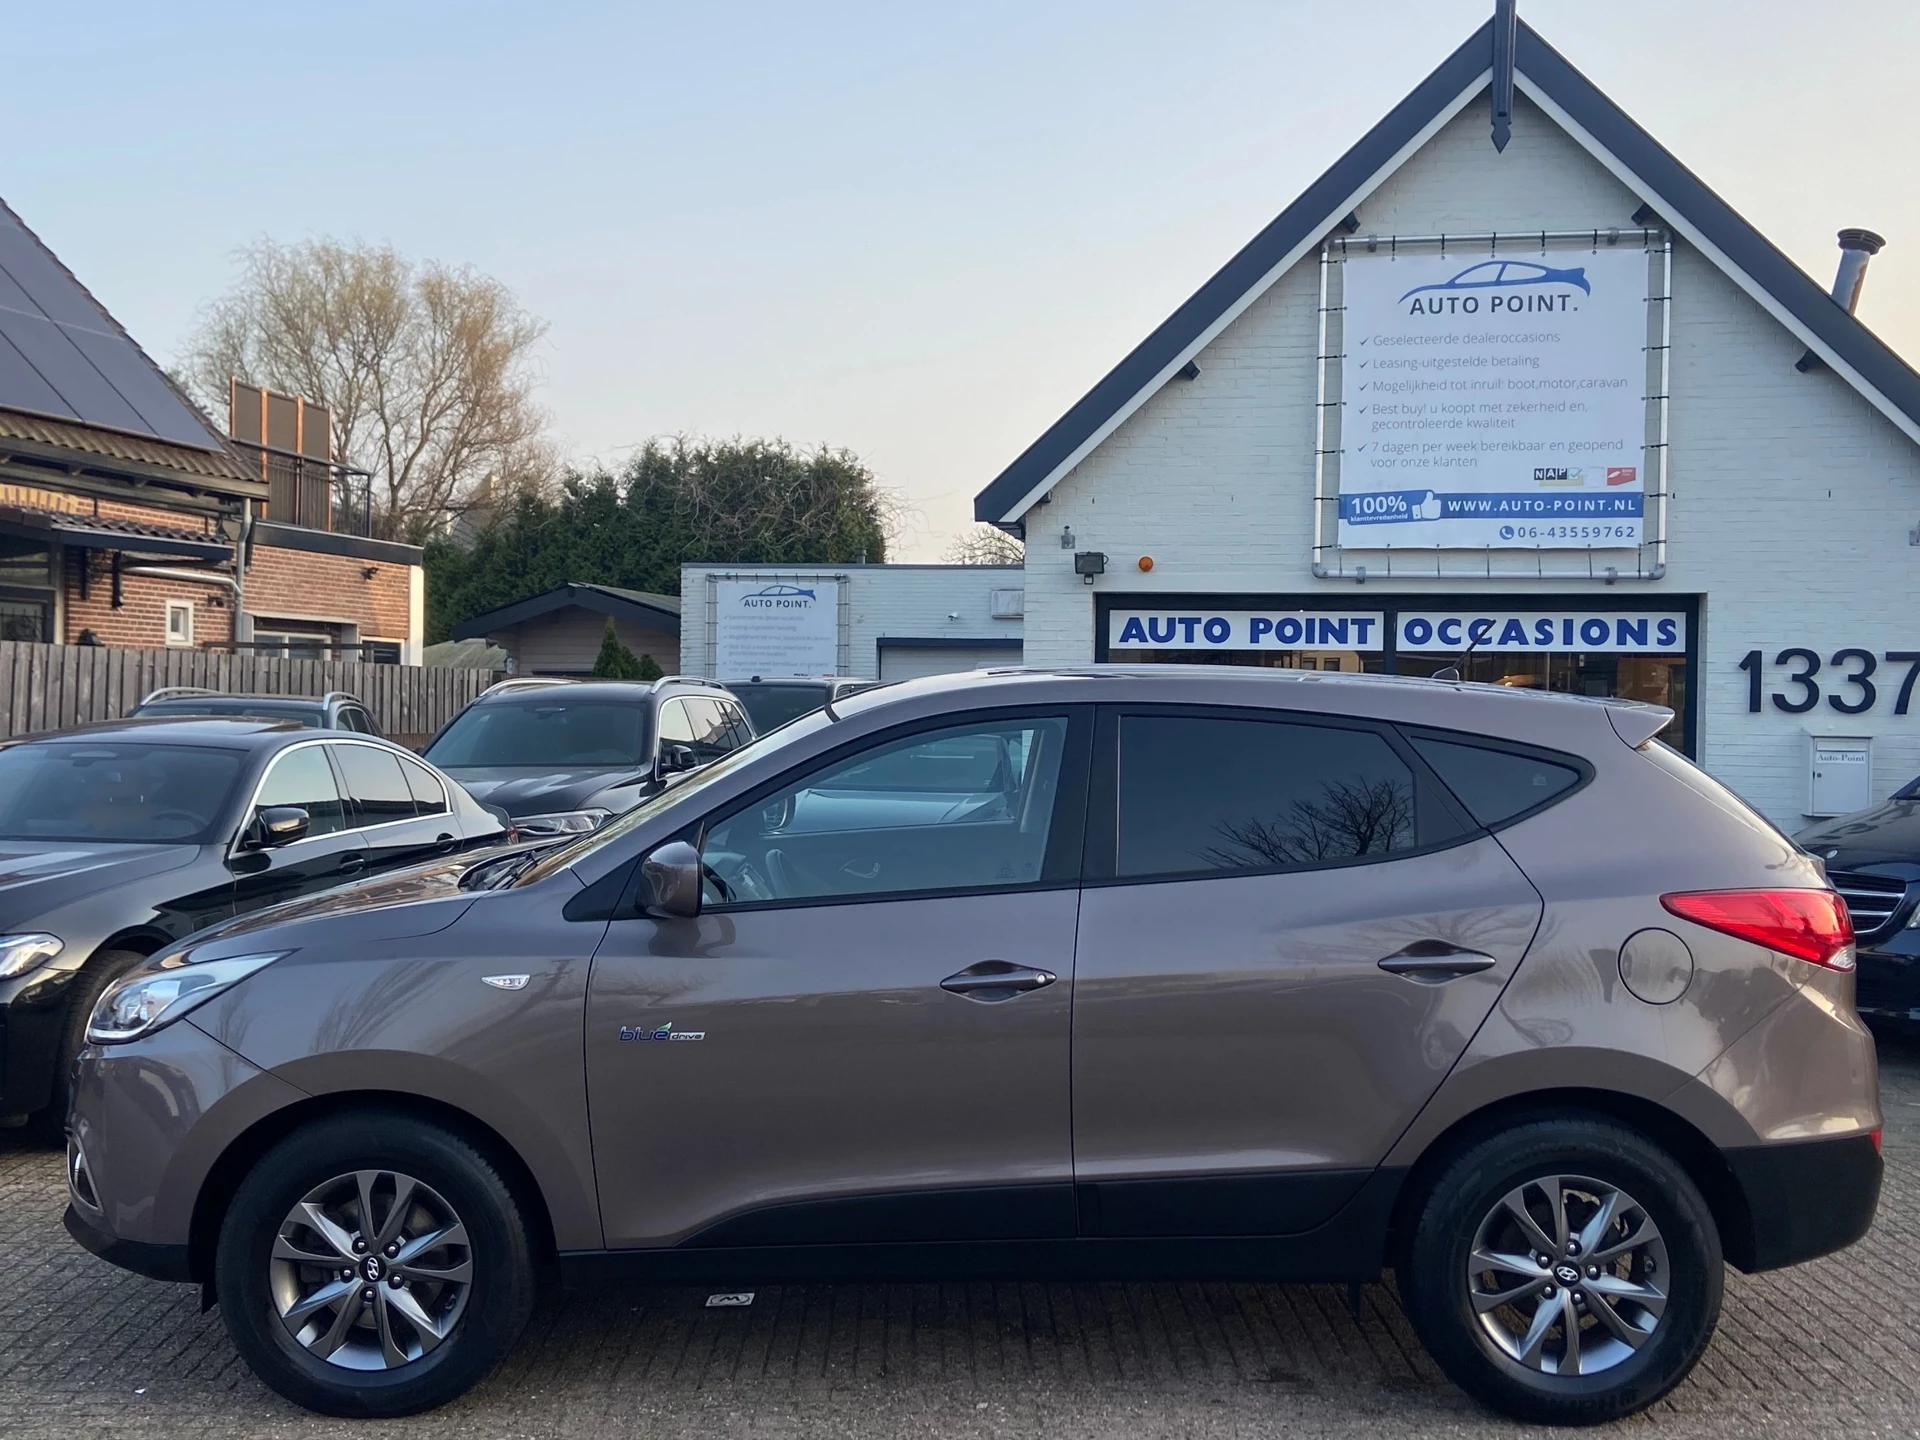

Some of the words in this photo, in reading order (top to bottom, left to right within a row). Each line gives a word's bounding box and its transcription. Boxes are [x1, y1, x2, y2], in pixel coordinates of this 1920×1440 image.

[1409, 296, 1479, 315] AUTO
[1373, 333, 1460, 346] Geselecteerde
[1462, 332, 1561, 344] dealeroccasions
[1373, 356, 1488, 371] Leasing-uitgestelde
[1491, 354, 1540, 369] betaling
[1372, 379, 1447, 394] Mogelijkheid
[1450, 380, 1468, 391] tot
[1372, 403, 1398, 415] Best
[1430, 404, 1438, 414] u
[1441, 402, 1476, 416] koopt
[1479, 403, 1503, 414] met
[1506, 401, 1566, 413] zekerheid
[1371, 418, 1463, 433] gecontroleerde
[1466, 418, 1515, 429] kwaliteit
[1371, 442, 1379, 452] 7
[1382, 441, 1419, 455] dagen
[1422, 442, 1443, 454] per
[1446, 441, 1478, 452] week
[1480, 440, 1546, 452] bereikbaar
[1549, 441, 1565, 451] en
[1567, 439, 1623, 454] geopend
[1371, 458, 1398, 468] voor
[1400, 457, 1430, 468] onze
[1433, 456, 1477, 467] klanten
[1351, 495, 1407, 514] 100%
[1448, 499, 1636, 512] WWW.AUTO-POINT.NL
[1517, 526, 1635, 538] 06-43559762
[743, 599, 772, 608] AUTO
[1118, 615, 1231, 645] AUTO
[1249, 616, 1376, 645] POINT
[1403, 617, 1677, 647] OCCASIONS
[1738, 647, 1920, 715] 1337
[1817, 753, 1865, 762] Auto-Point
[619, 1025, 669, 1041] blue
[671, 1032, 703, 1040] drive
